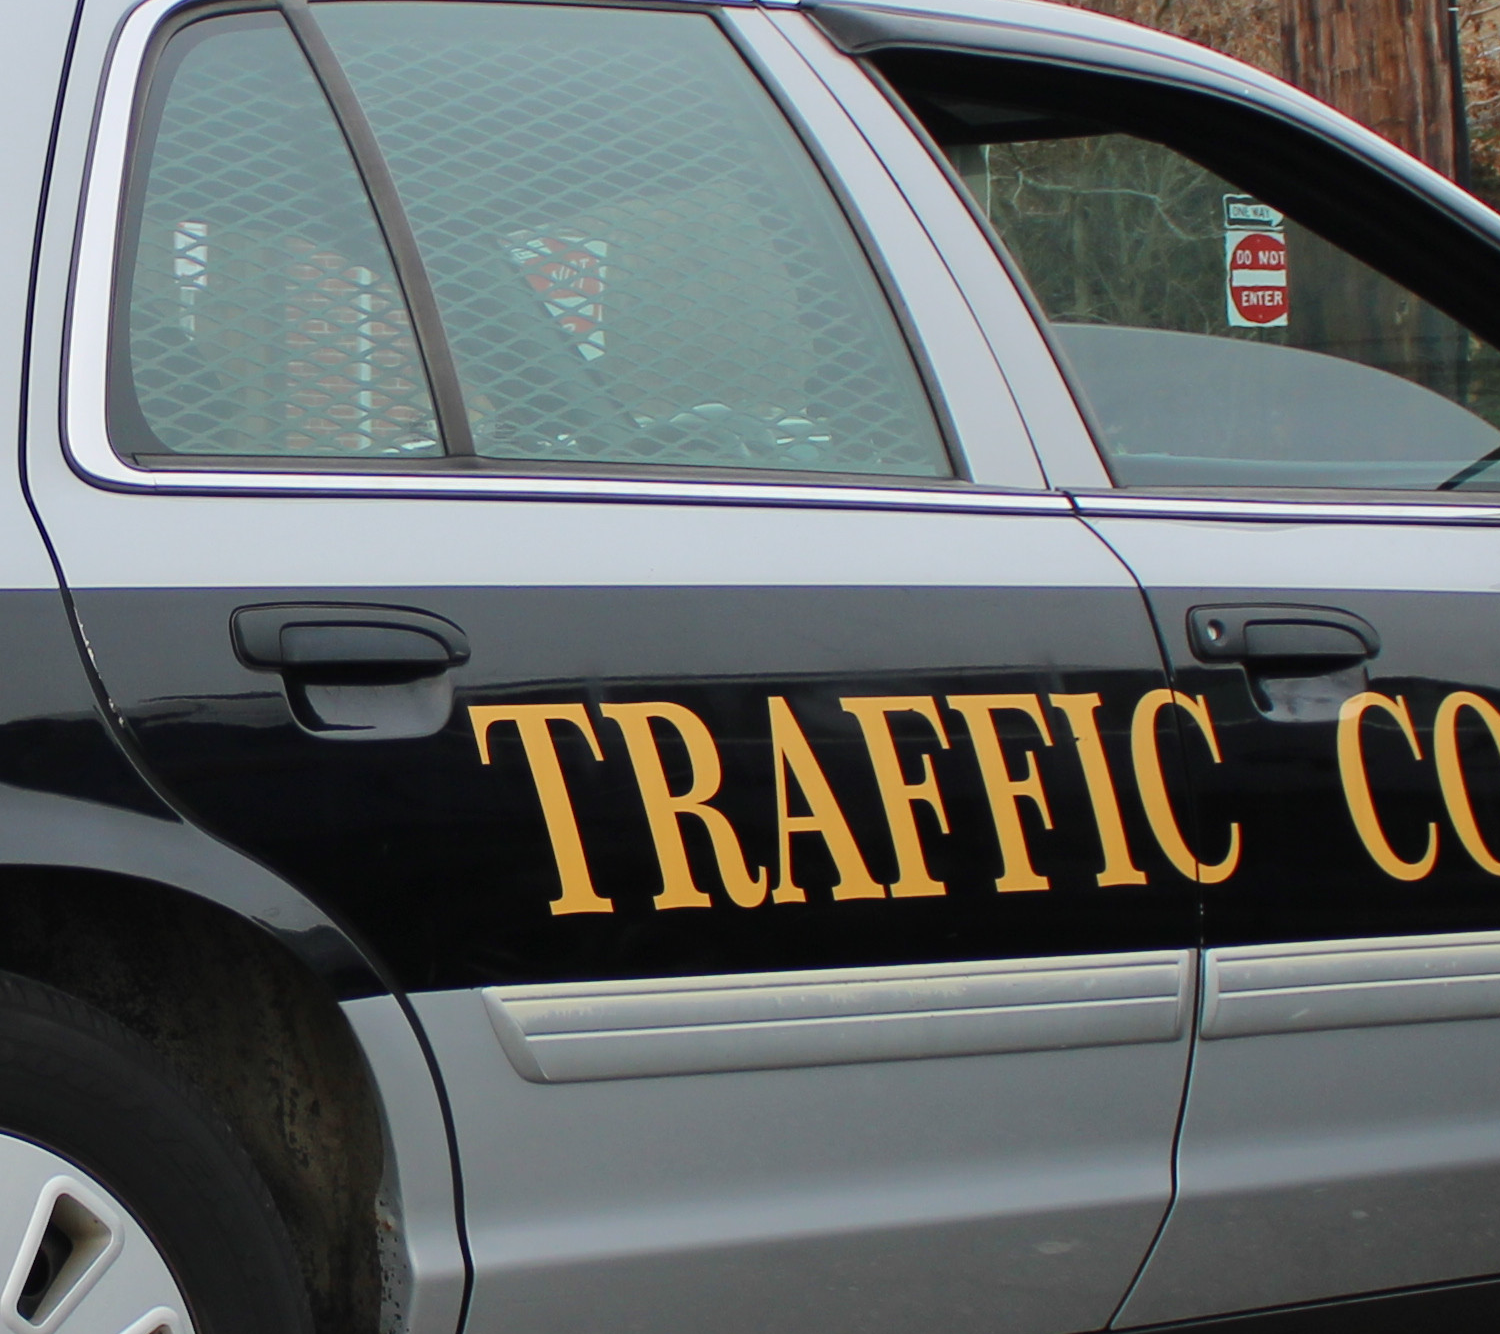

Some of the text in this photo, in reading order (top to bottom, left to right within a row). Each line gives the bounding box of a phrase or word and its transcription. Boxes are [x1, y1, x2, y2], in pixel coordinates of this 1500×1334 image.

[1236, 250, 1285, 265] DO NOT
[1241, 290, 1283, 306] ENTER
[467, 691, 1242, 916] TRAFFIC
